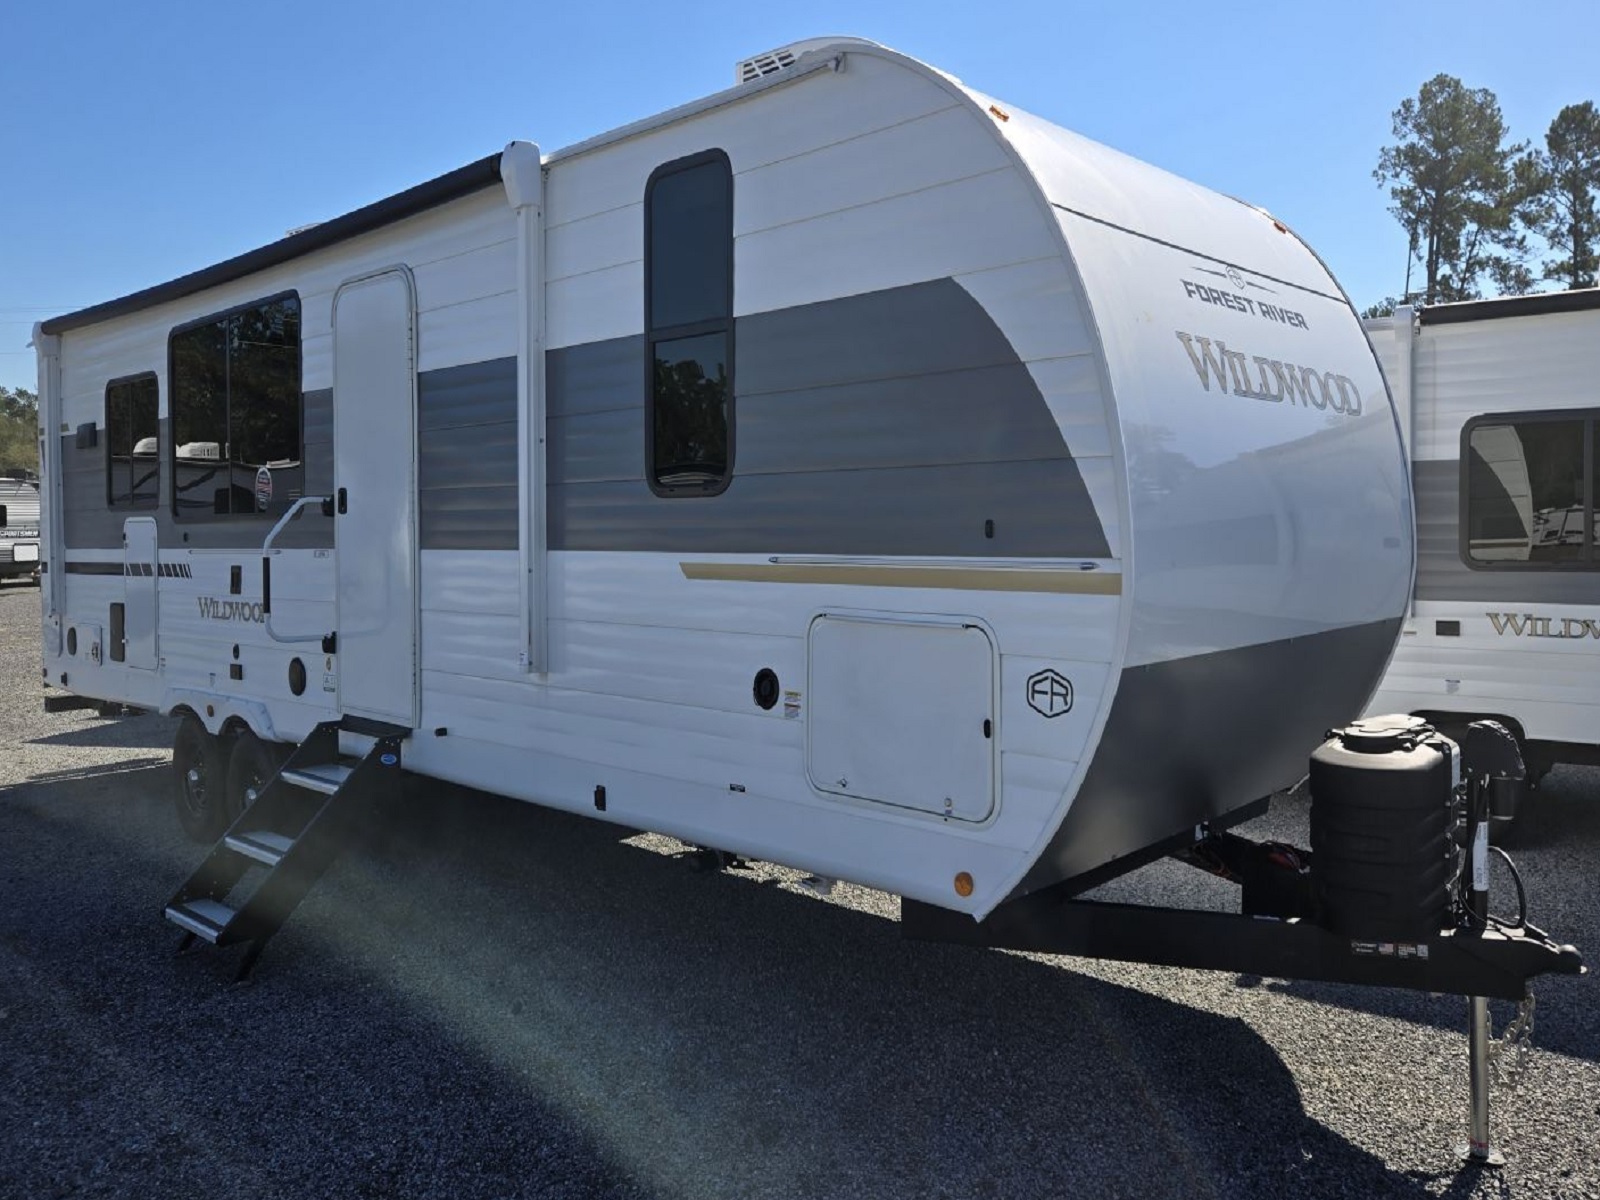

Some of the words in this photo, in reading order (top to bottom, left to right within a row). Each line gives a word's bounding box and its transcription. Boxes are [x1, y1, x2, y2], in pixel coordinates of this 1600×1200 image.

[1180, 279, 1256, 316] FOREST
[1256, 301, 1310, 330] RIVER
[1175, 330, 1362, 416] WILDWOOD
